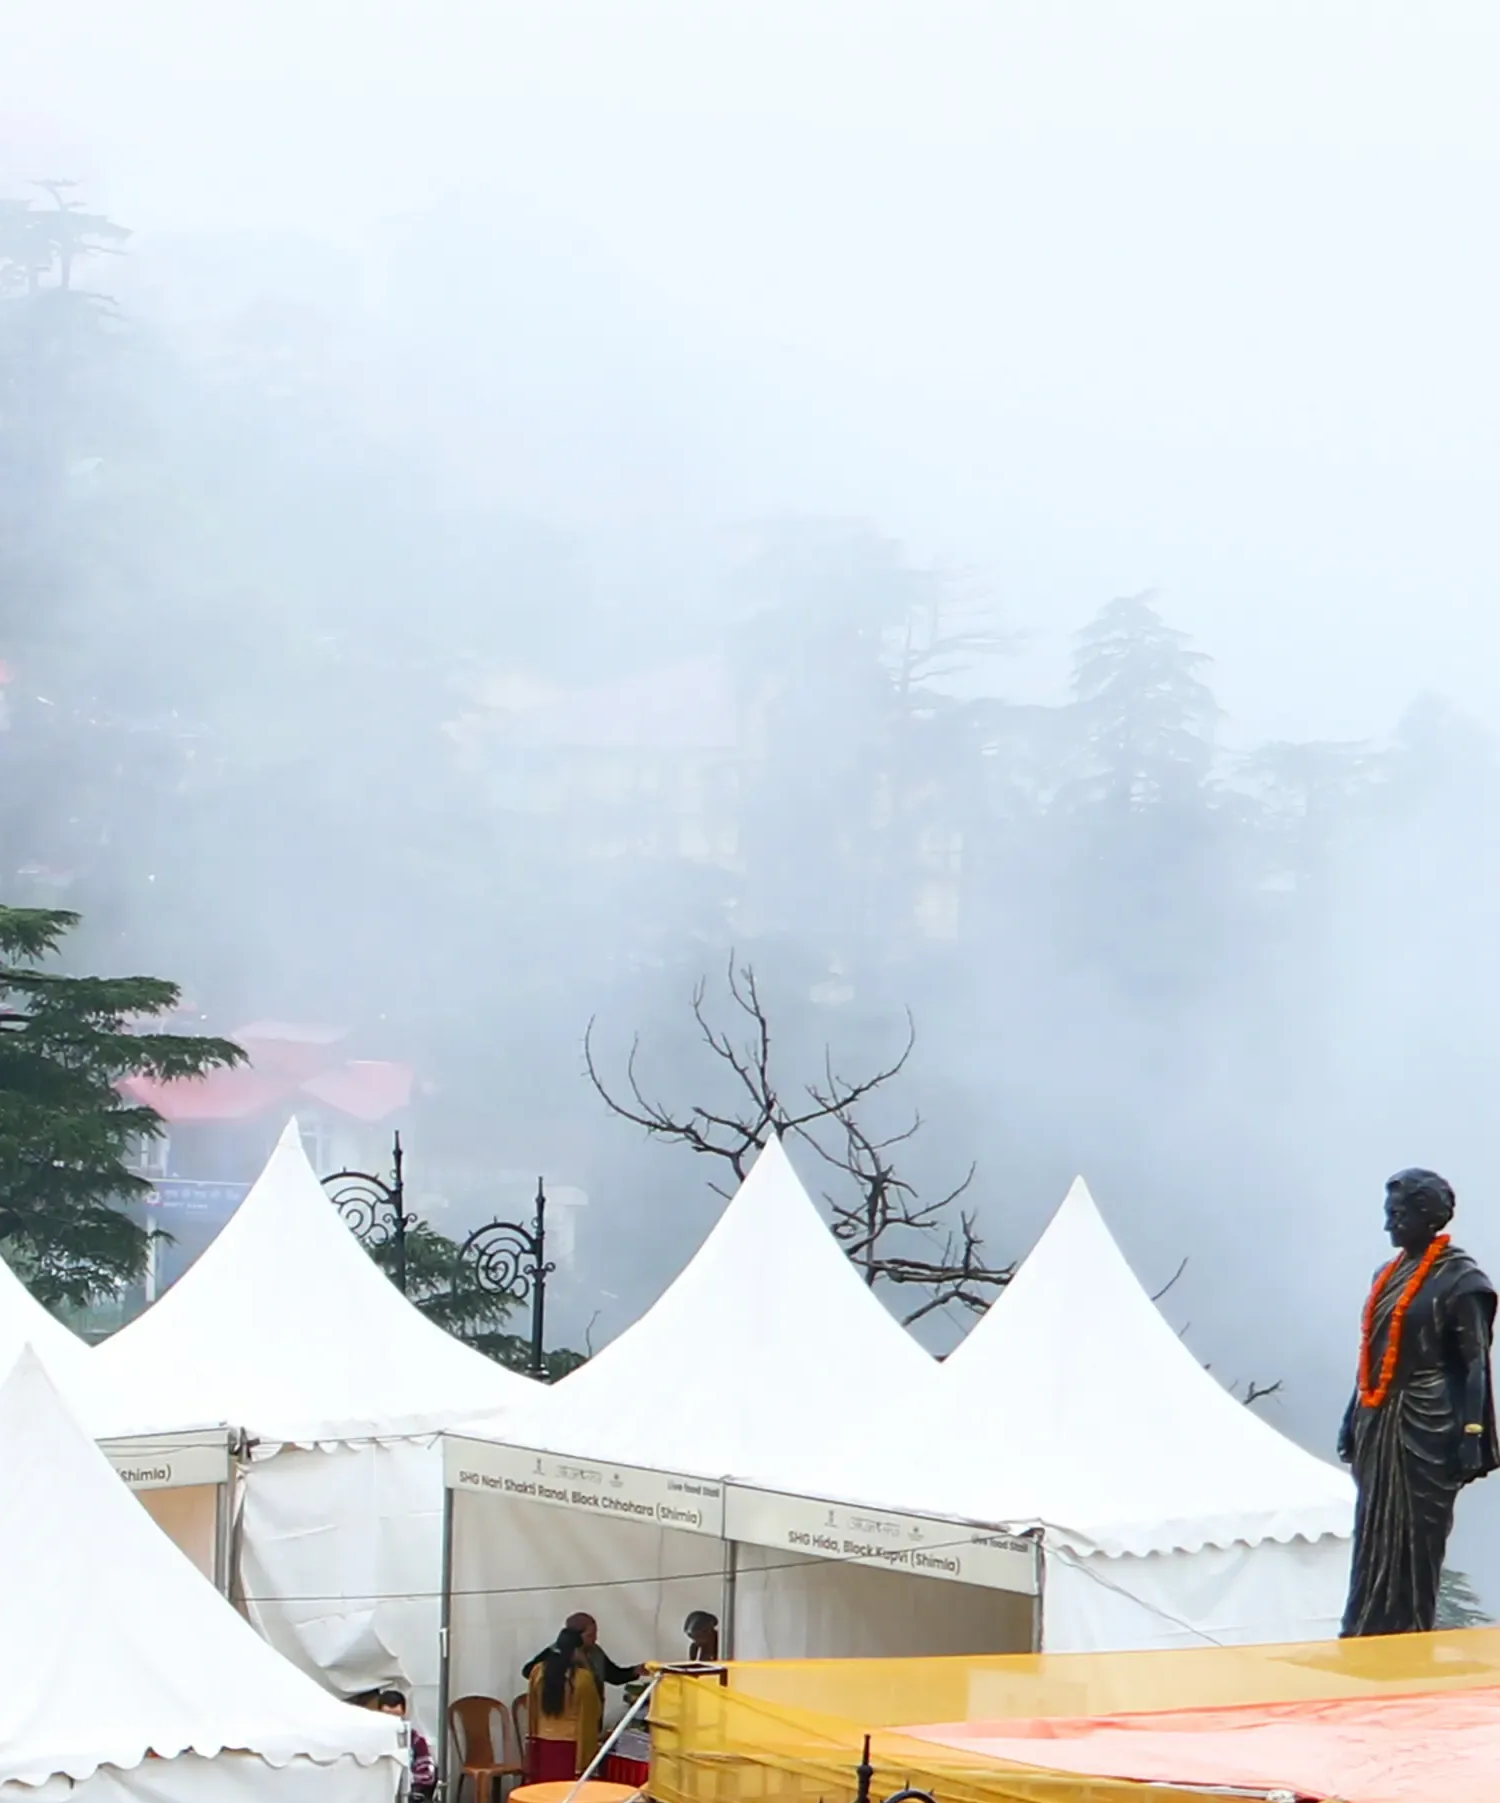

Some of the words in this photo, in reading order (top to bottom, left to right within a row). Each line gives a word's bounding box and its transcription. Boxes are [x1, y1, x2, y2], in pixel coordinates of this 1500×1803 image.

[571, 1489, 600, 1508] Block
[655, 1502, 703, 1529] (Shimla)
[787, 1530, 811, 1546] SHG
[910, 1551, 961, 1575] (Shimla)
